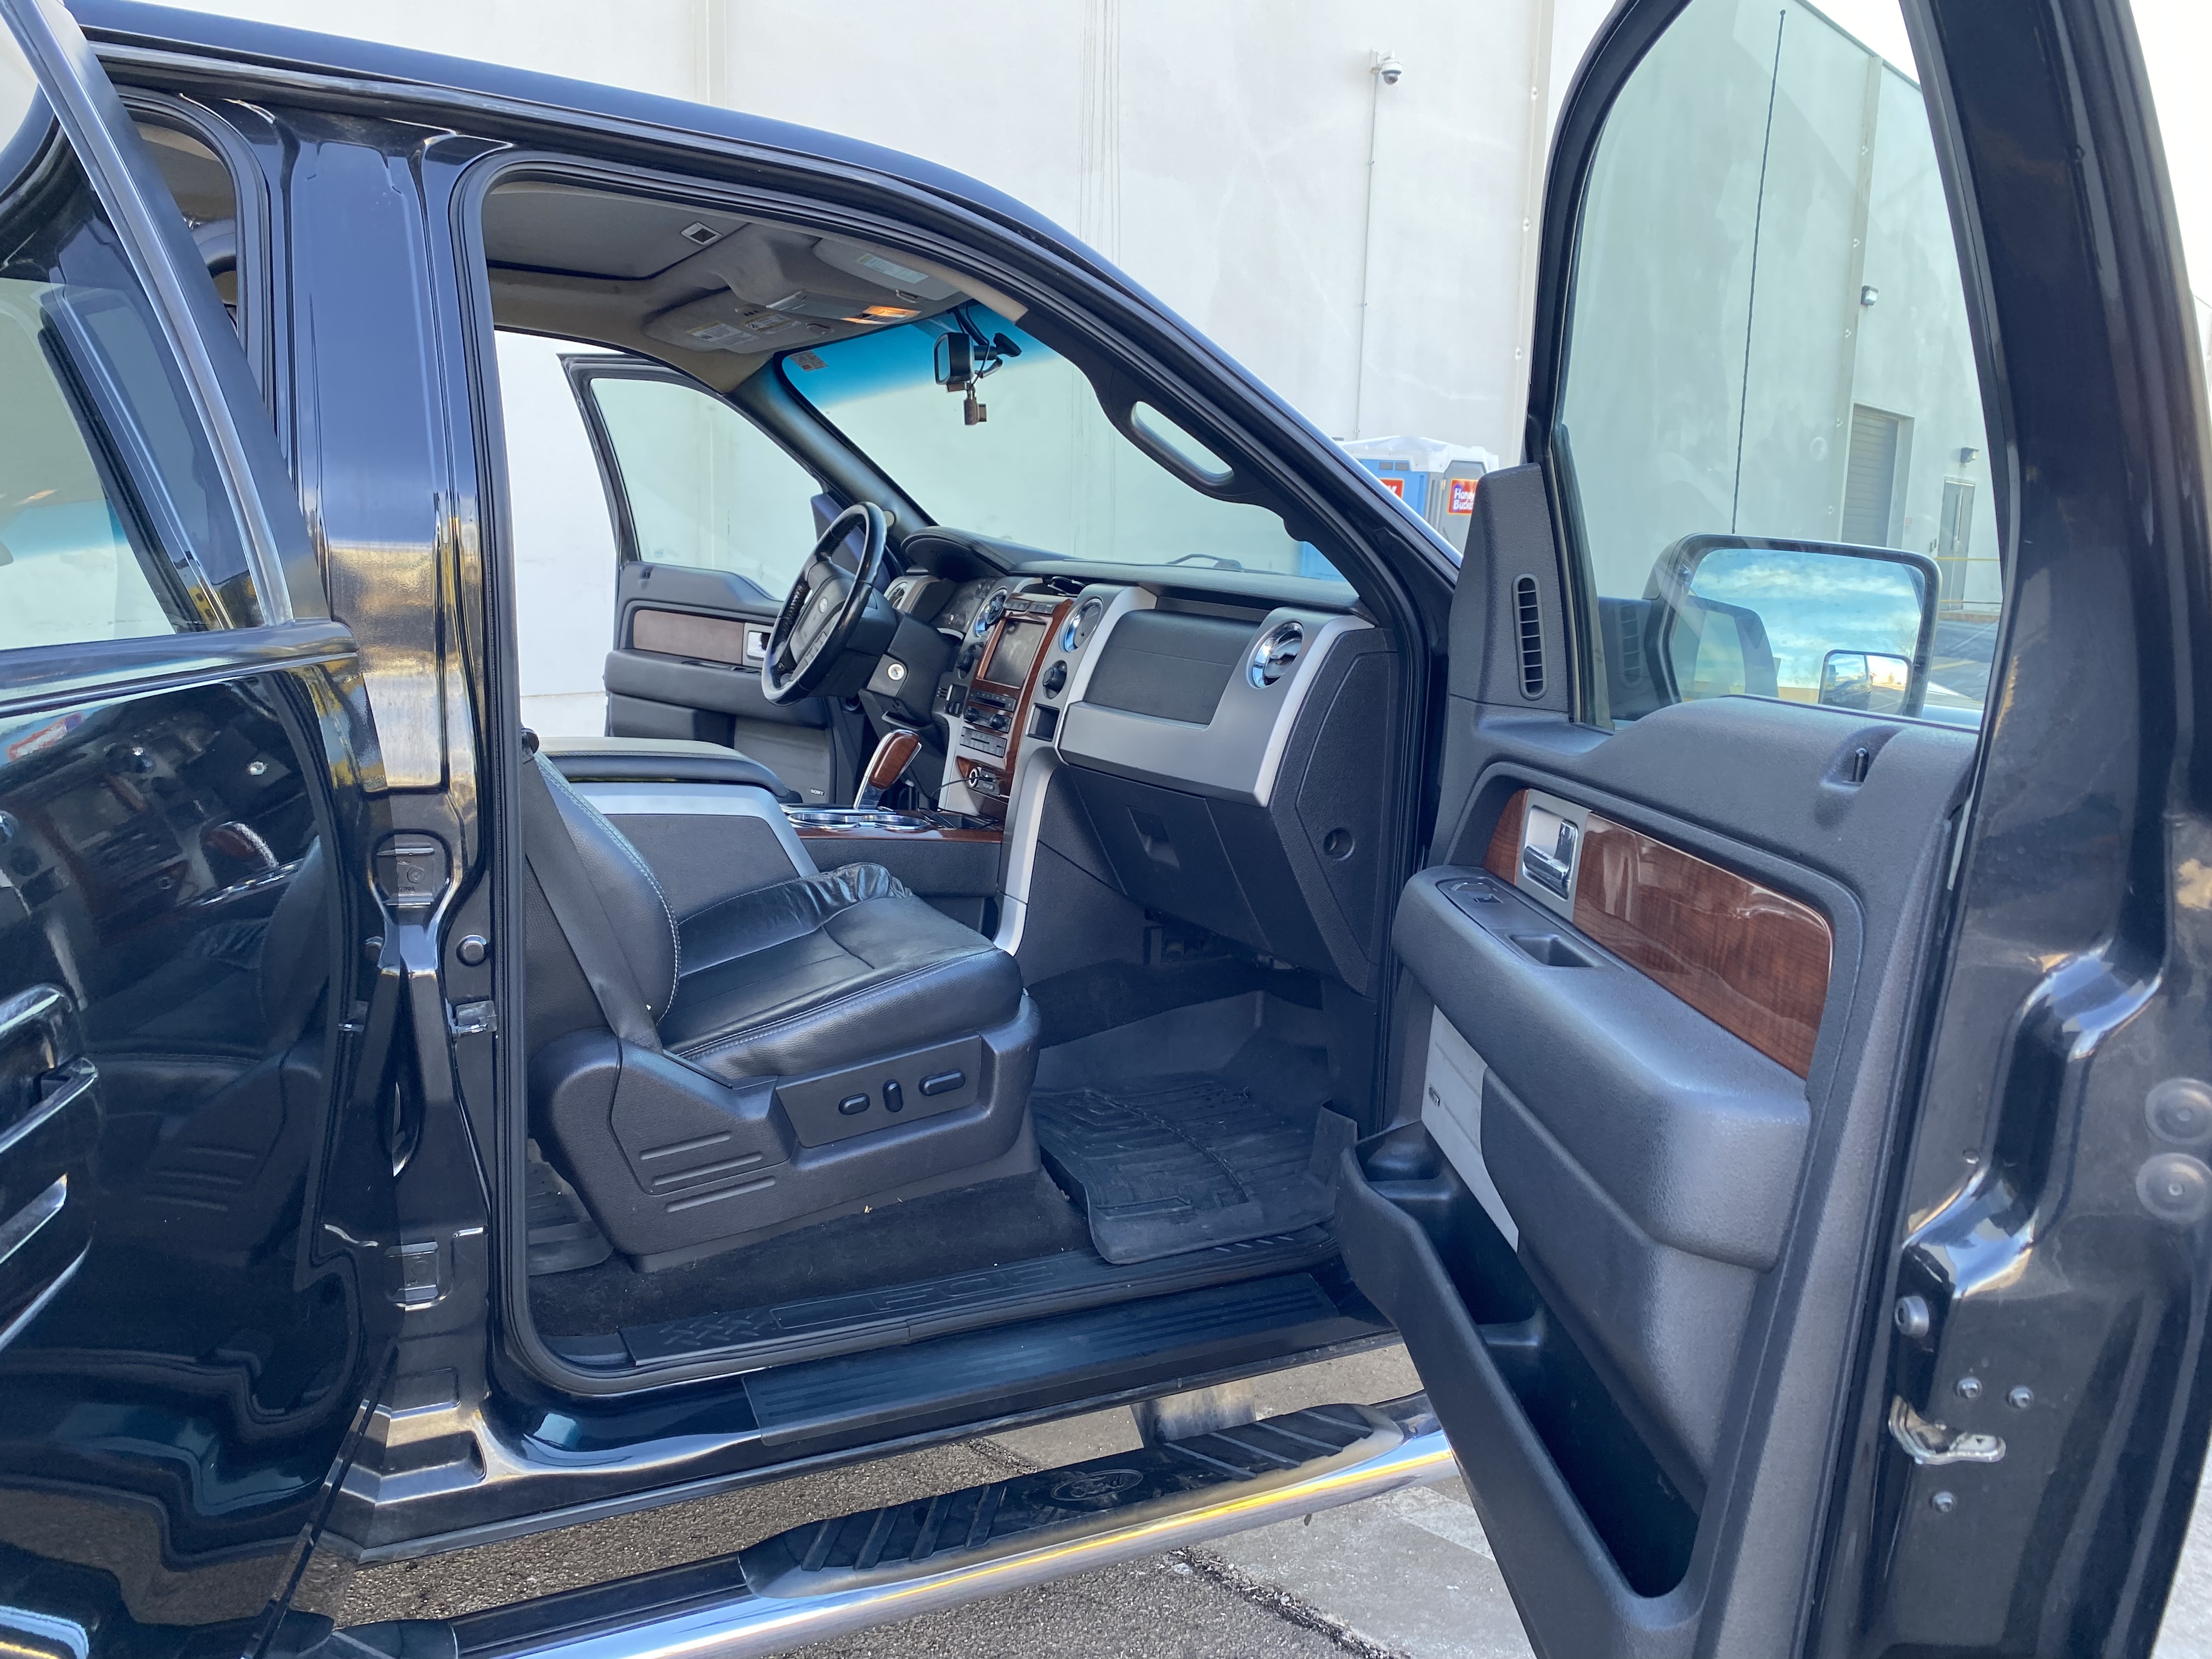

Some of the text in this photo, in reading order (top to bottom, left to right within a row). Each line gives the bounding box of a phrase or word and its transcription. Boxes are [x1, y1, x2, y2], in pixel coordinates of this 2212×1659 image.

[1453, 499, 1474, 510] Bucke
[868, 1261, 1082, 1311] FOR
[1069, 1472, 1129, 1498] Ford
